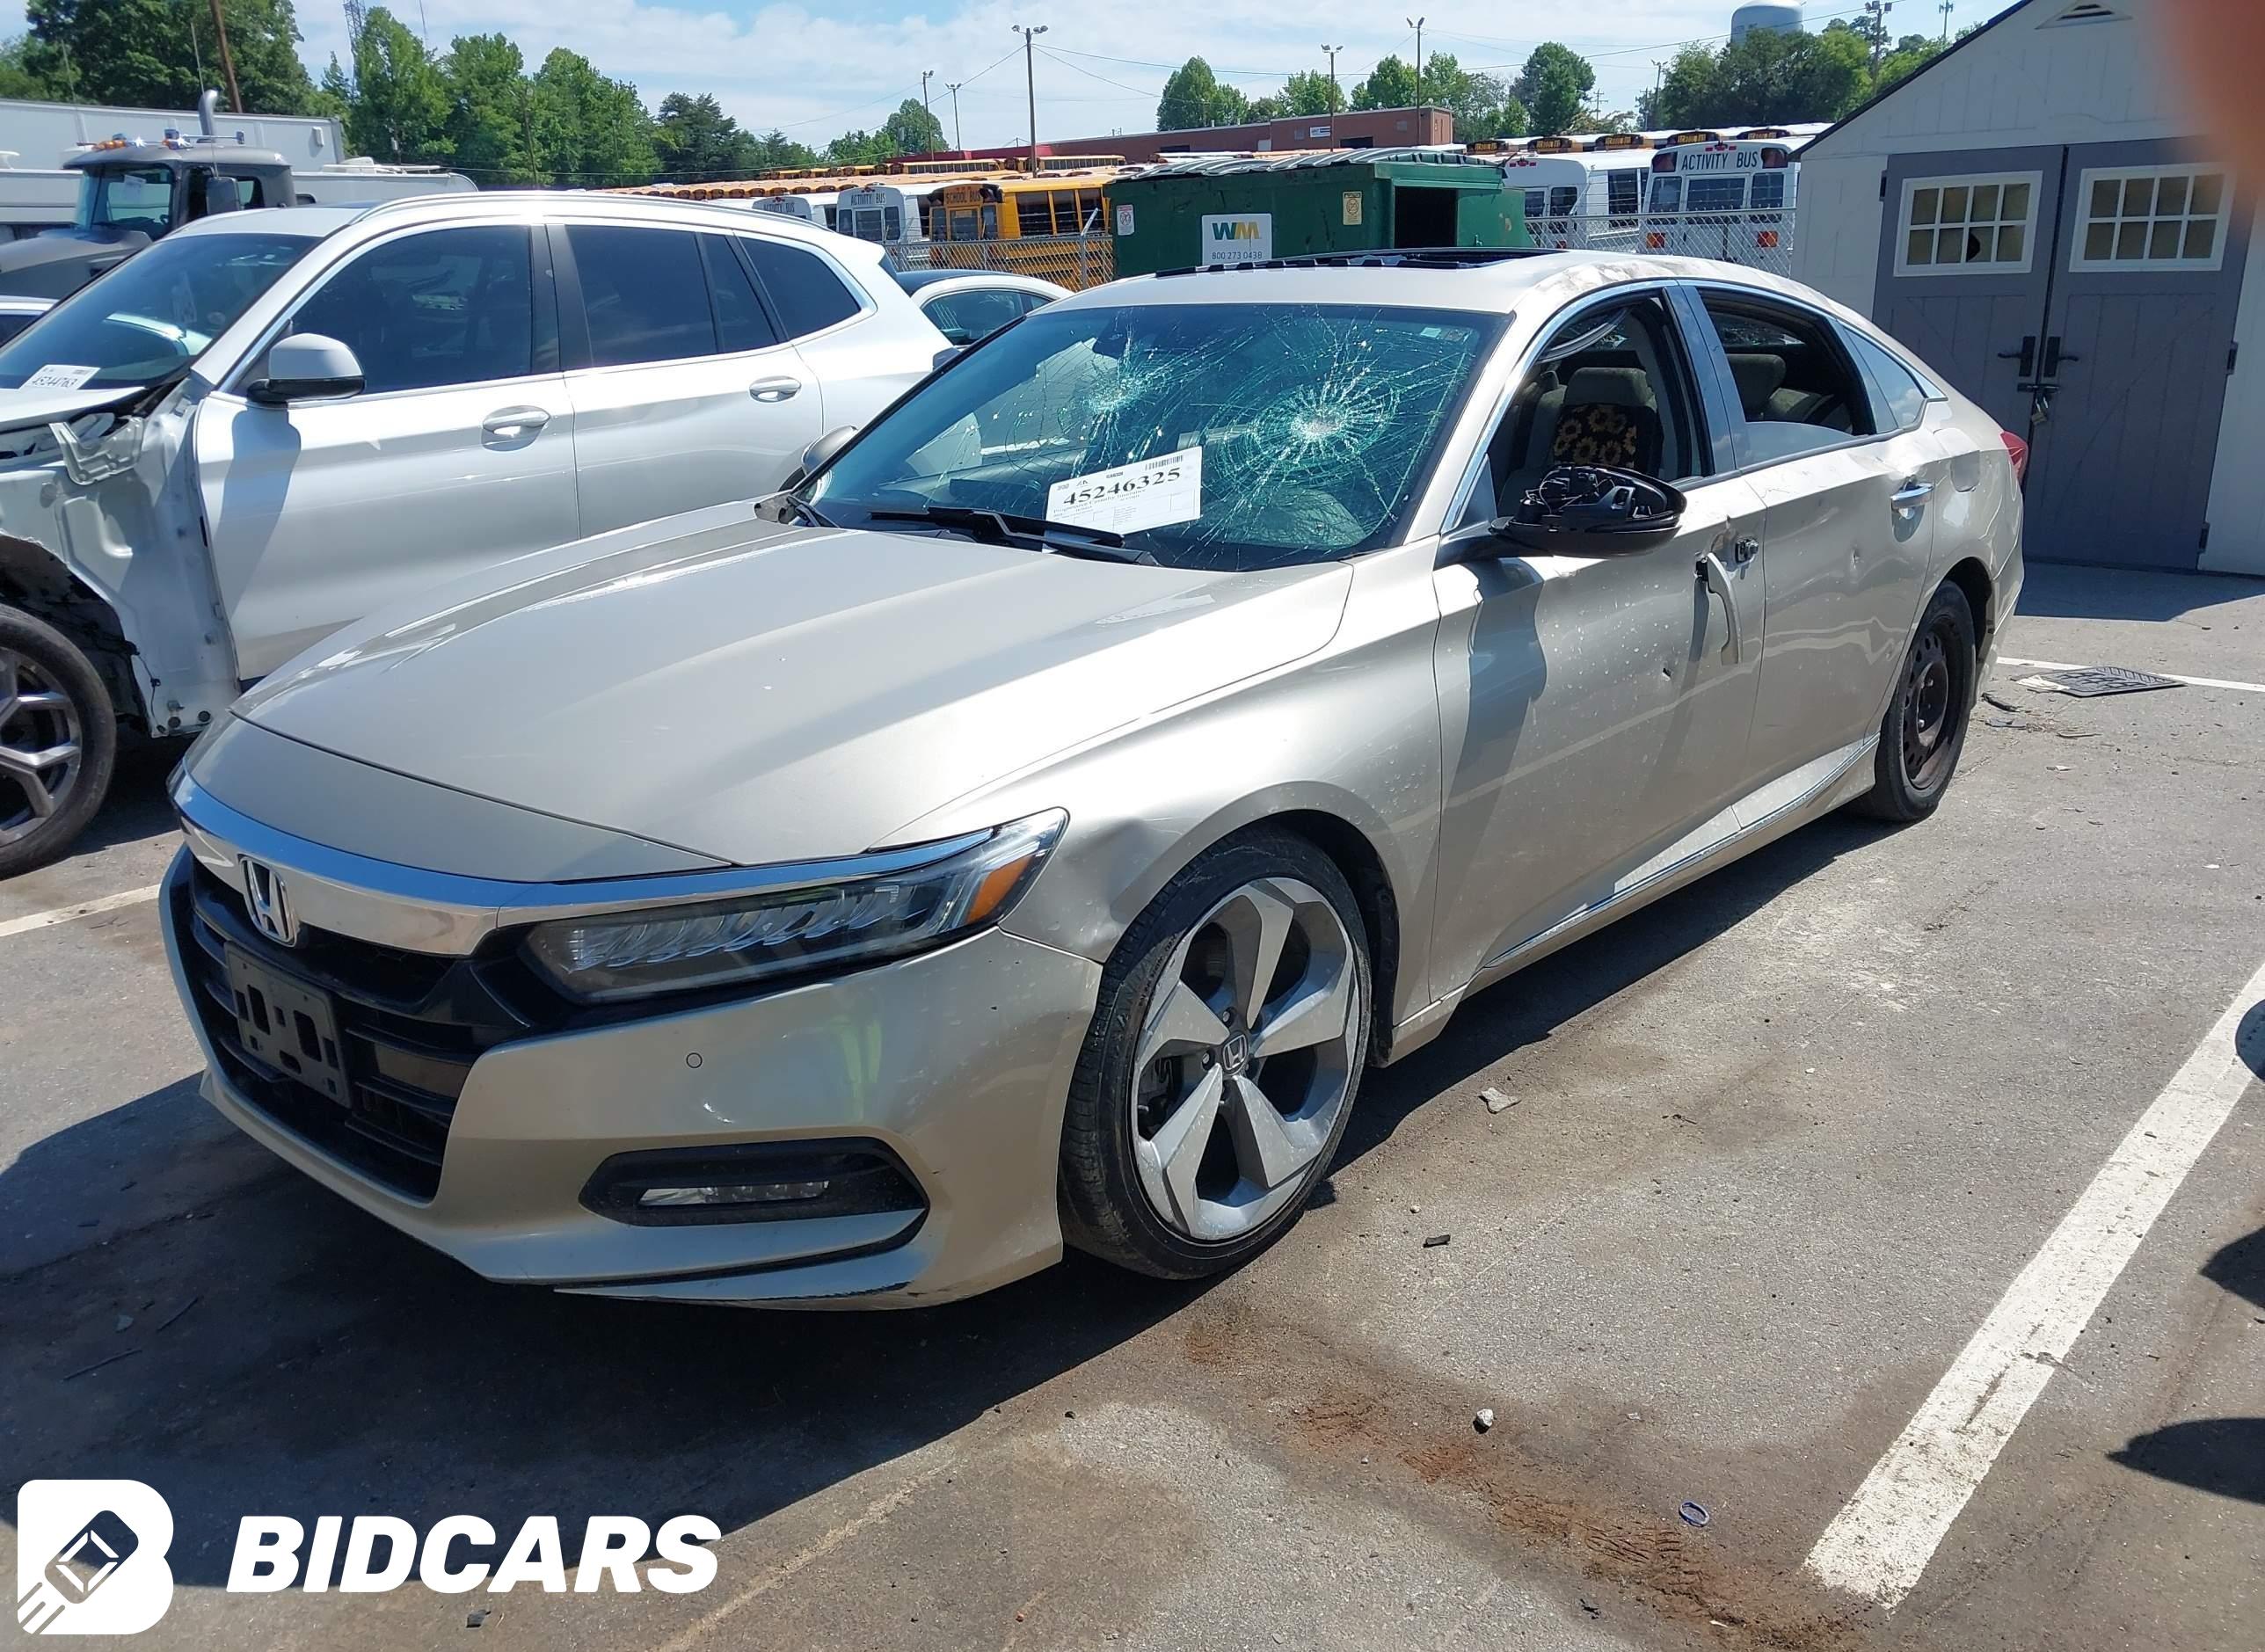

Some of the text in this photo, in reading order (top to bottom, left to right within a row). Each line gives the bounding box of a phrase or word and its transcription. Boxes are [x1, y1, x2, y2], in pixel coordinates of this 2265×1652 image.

[1681, 151, 1758, 171] ACTIVITY BUS
[851, 193, 886, 206] ACTIVITY BUS
[946, 190, 981, 204] SCHOOL BUS
[786, 202, 795, 213] BUS
[1212, 221, 1260, 241] WM
[1212, 251, 1263, 260] 800 273 0438
[1063, 467, 1181, 506] 45246325
